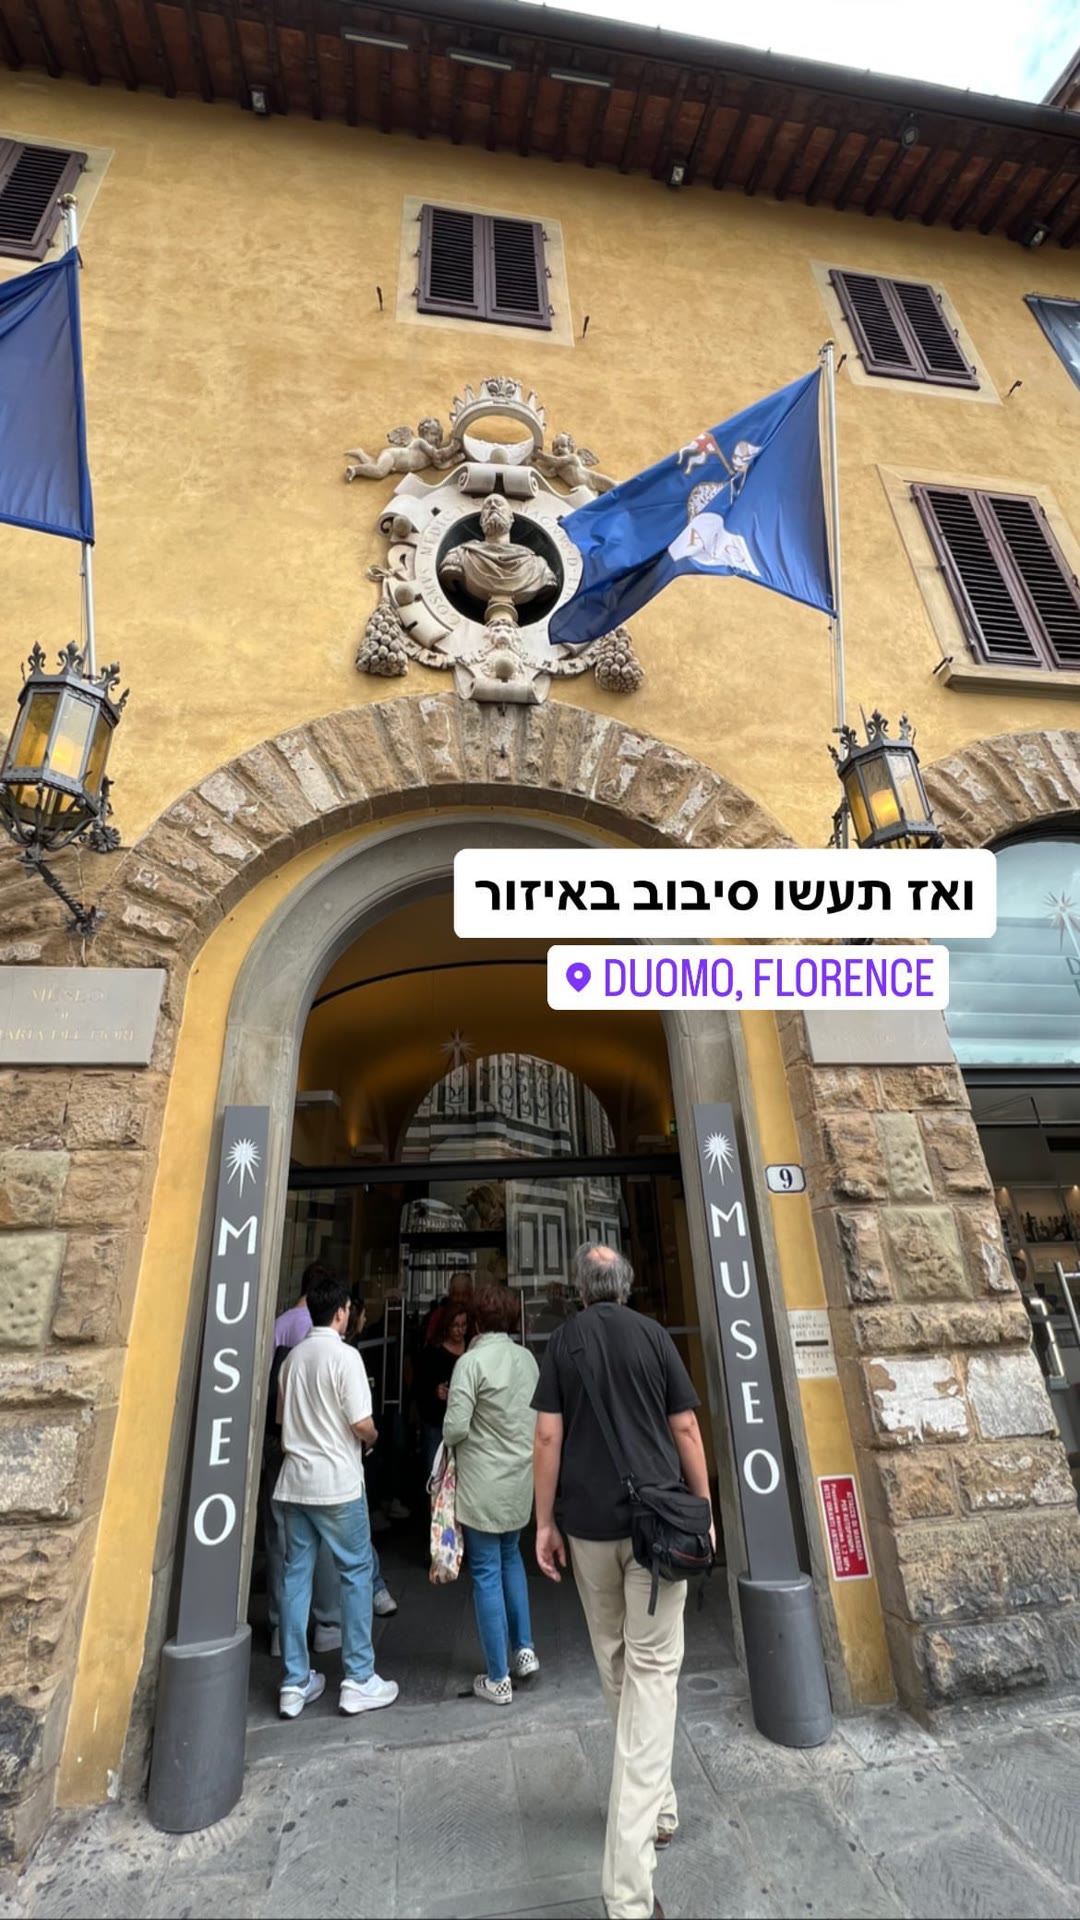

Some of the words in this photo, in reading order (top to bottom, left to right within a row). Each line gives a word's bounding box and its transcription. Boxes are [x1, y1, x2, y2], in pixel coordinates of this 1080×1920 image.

[779, 1168, 793, 1189] 9
[194, 1215, 258, 1546] MUSEO
[710, 1201, 780, 1495] MUSEO
